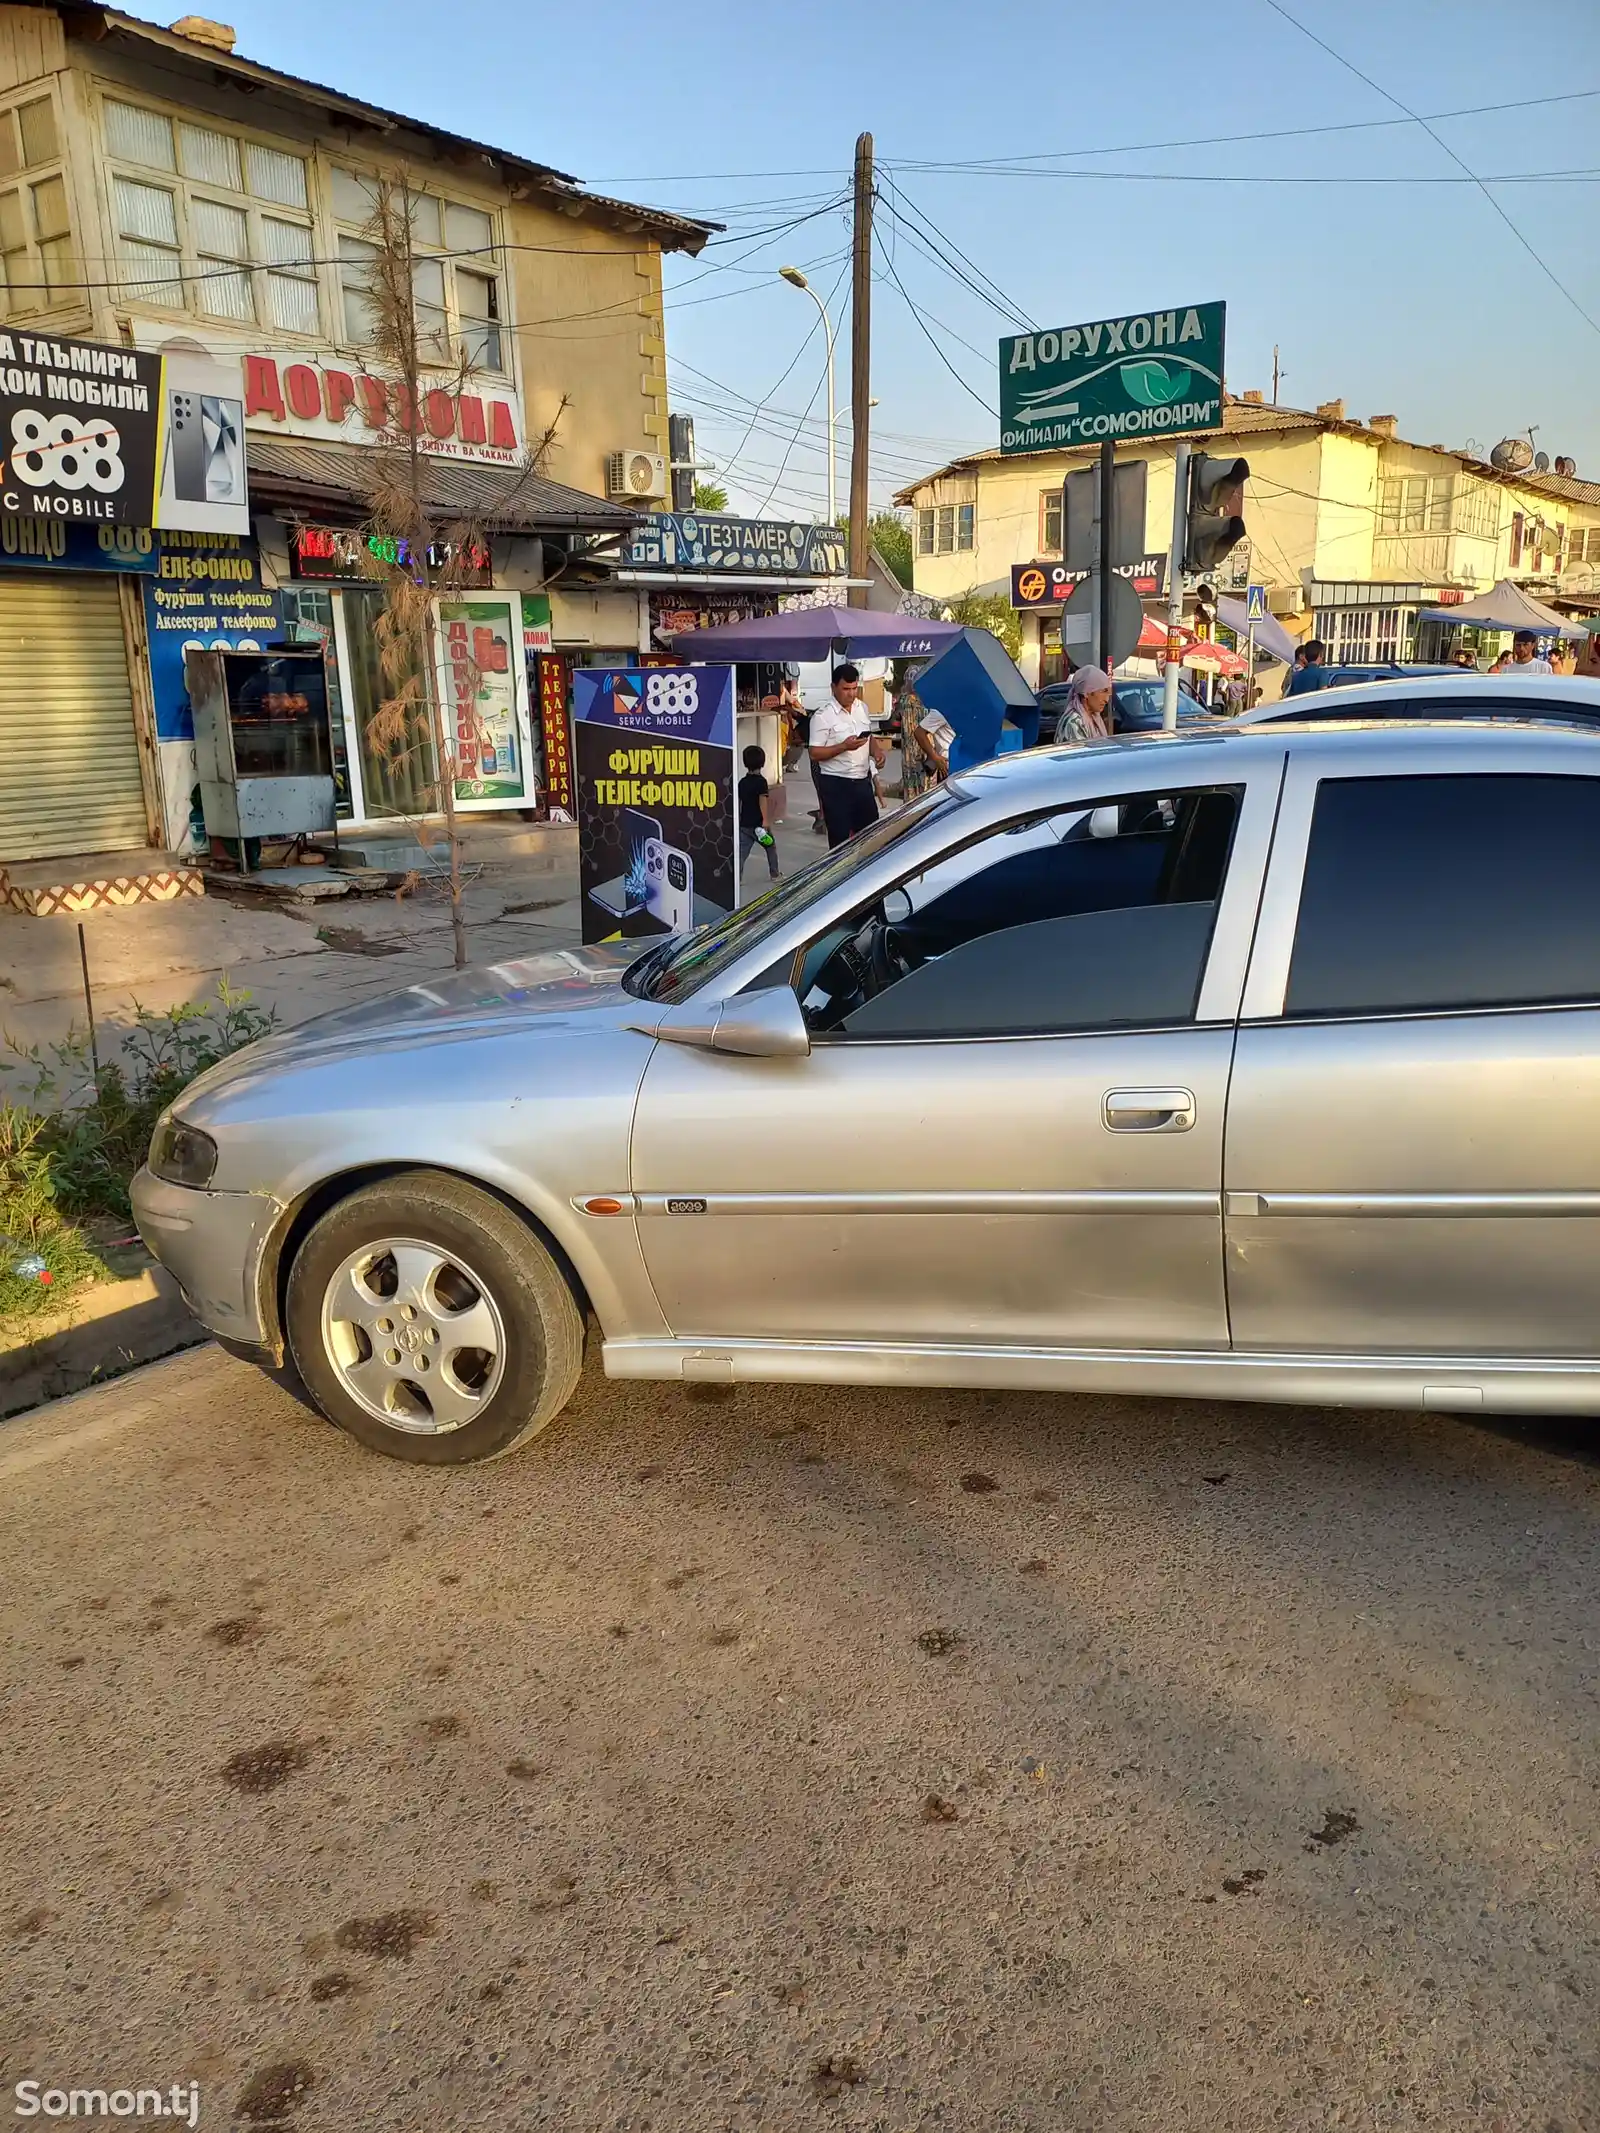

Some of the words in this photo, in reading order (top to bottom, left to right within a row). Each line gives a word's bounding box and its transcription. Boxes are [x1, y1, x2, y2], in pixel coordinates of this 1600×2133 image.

[1009, 309, 1203, 374] ДОРУХОНА
[20, 338, 138, 381] ТАЪМИРИ
[241, 354, 518, 449] ДОРУХОНА
[11, 409, 125, 494] 888
[1002, 423, 1072, 449] ФИЛИАЛИ
[462, 446, 475, 457] ВА
[479, 449, 514, 462] ЧАКАНА
[33, 494, 115, 518] MOBILE
[699, 522, 788, 550] ТЕЗТАЙЁР
[156, 556, 253, 582] ЕЛЕФОНҲО
[156, 612, 218, 632] Аксессуари
[646, 673, 699, 714] 888
[541, 661, 558, 792] ТАЪМИРИ
[619, 716, 653, 726] SERVIC
[656, 716, 692, 726] MOBILE
[608, 745, 700, 776] ФУРӮШИ
[594, 780, 718, 811] ТЕЛЕФОНҲО
